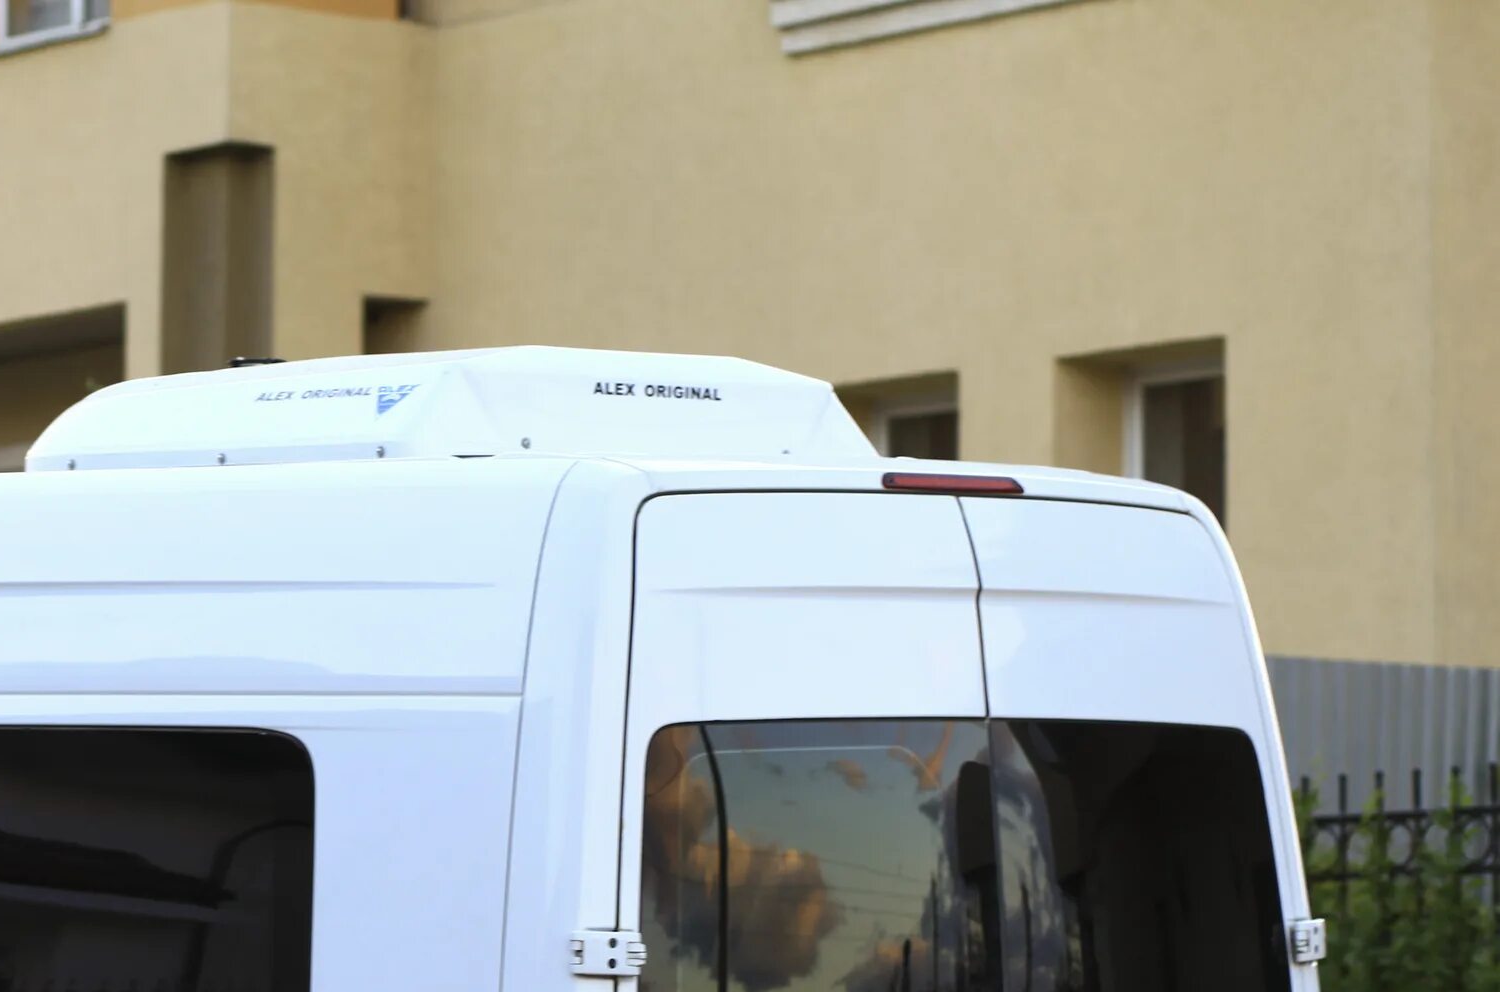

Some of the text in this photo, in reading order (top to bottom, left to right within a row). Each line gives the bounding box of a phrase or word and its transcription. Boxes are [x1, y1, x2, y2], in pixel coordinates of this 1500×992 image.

[256, 387, 372, 402] ALEX ORIGINAL
[593, 382, 722, 401] ALEX ORIGINAL
